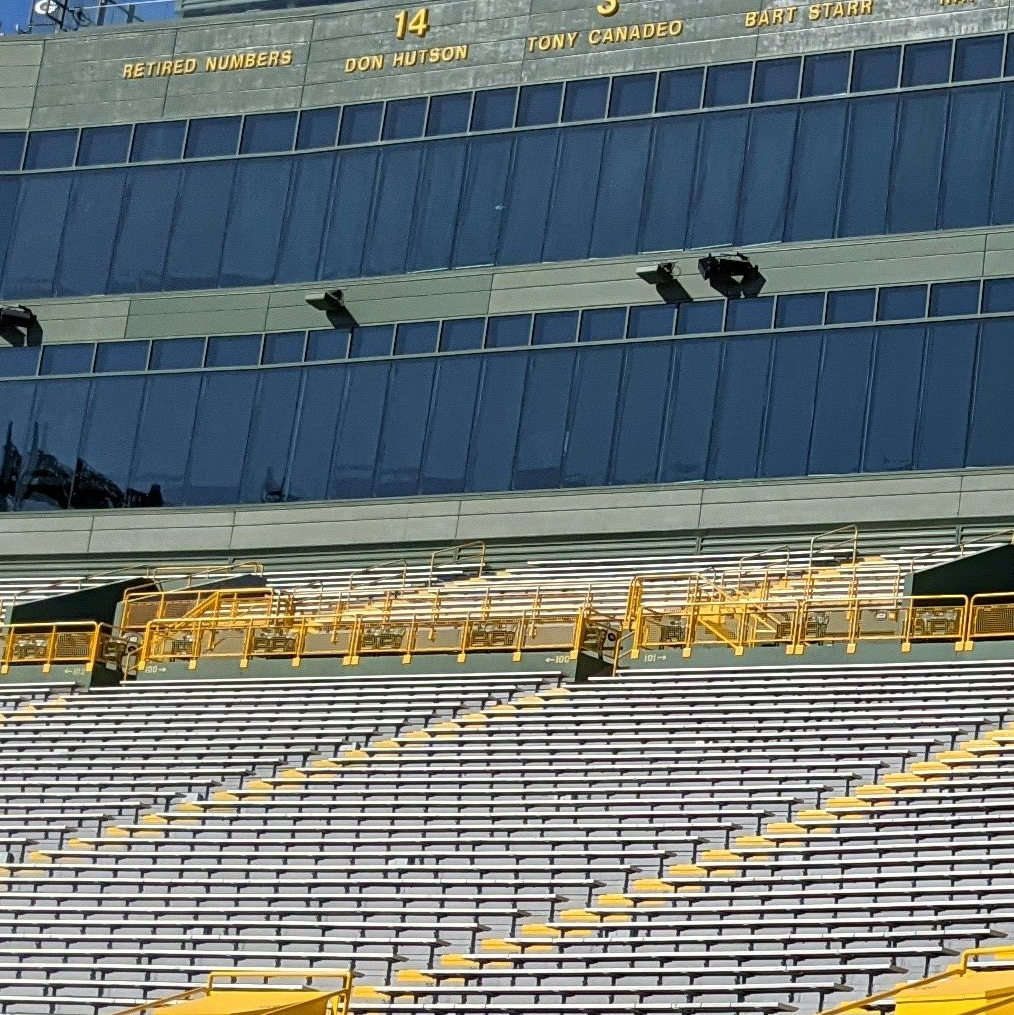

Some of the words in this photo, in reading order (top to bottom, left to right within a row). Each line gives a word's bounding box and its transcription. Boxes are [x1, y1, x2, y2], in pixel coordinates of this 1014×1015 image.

[394, 8, 430, 40] 14
[745, 7, 798, 28] BART
[808, 0, 875, 21] STARR
[527, 32, 579, 52] TONY
[588, 20, 684, 45] CANADEO
[123, 58, 197, 79] RETIRED
[205, 50, 293, 72] NUMBERS
[345, 54, 384, 73] DON
[393, 44, 469, 68] HUTSON
[644, 653, 656, 663] 101
